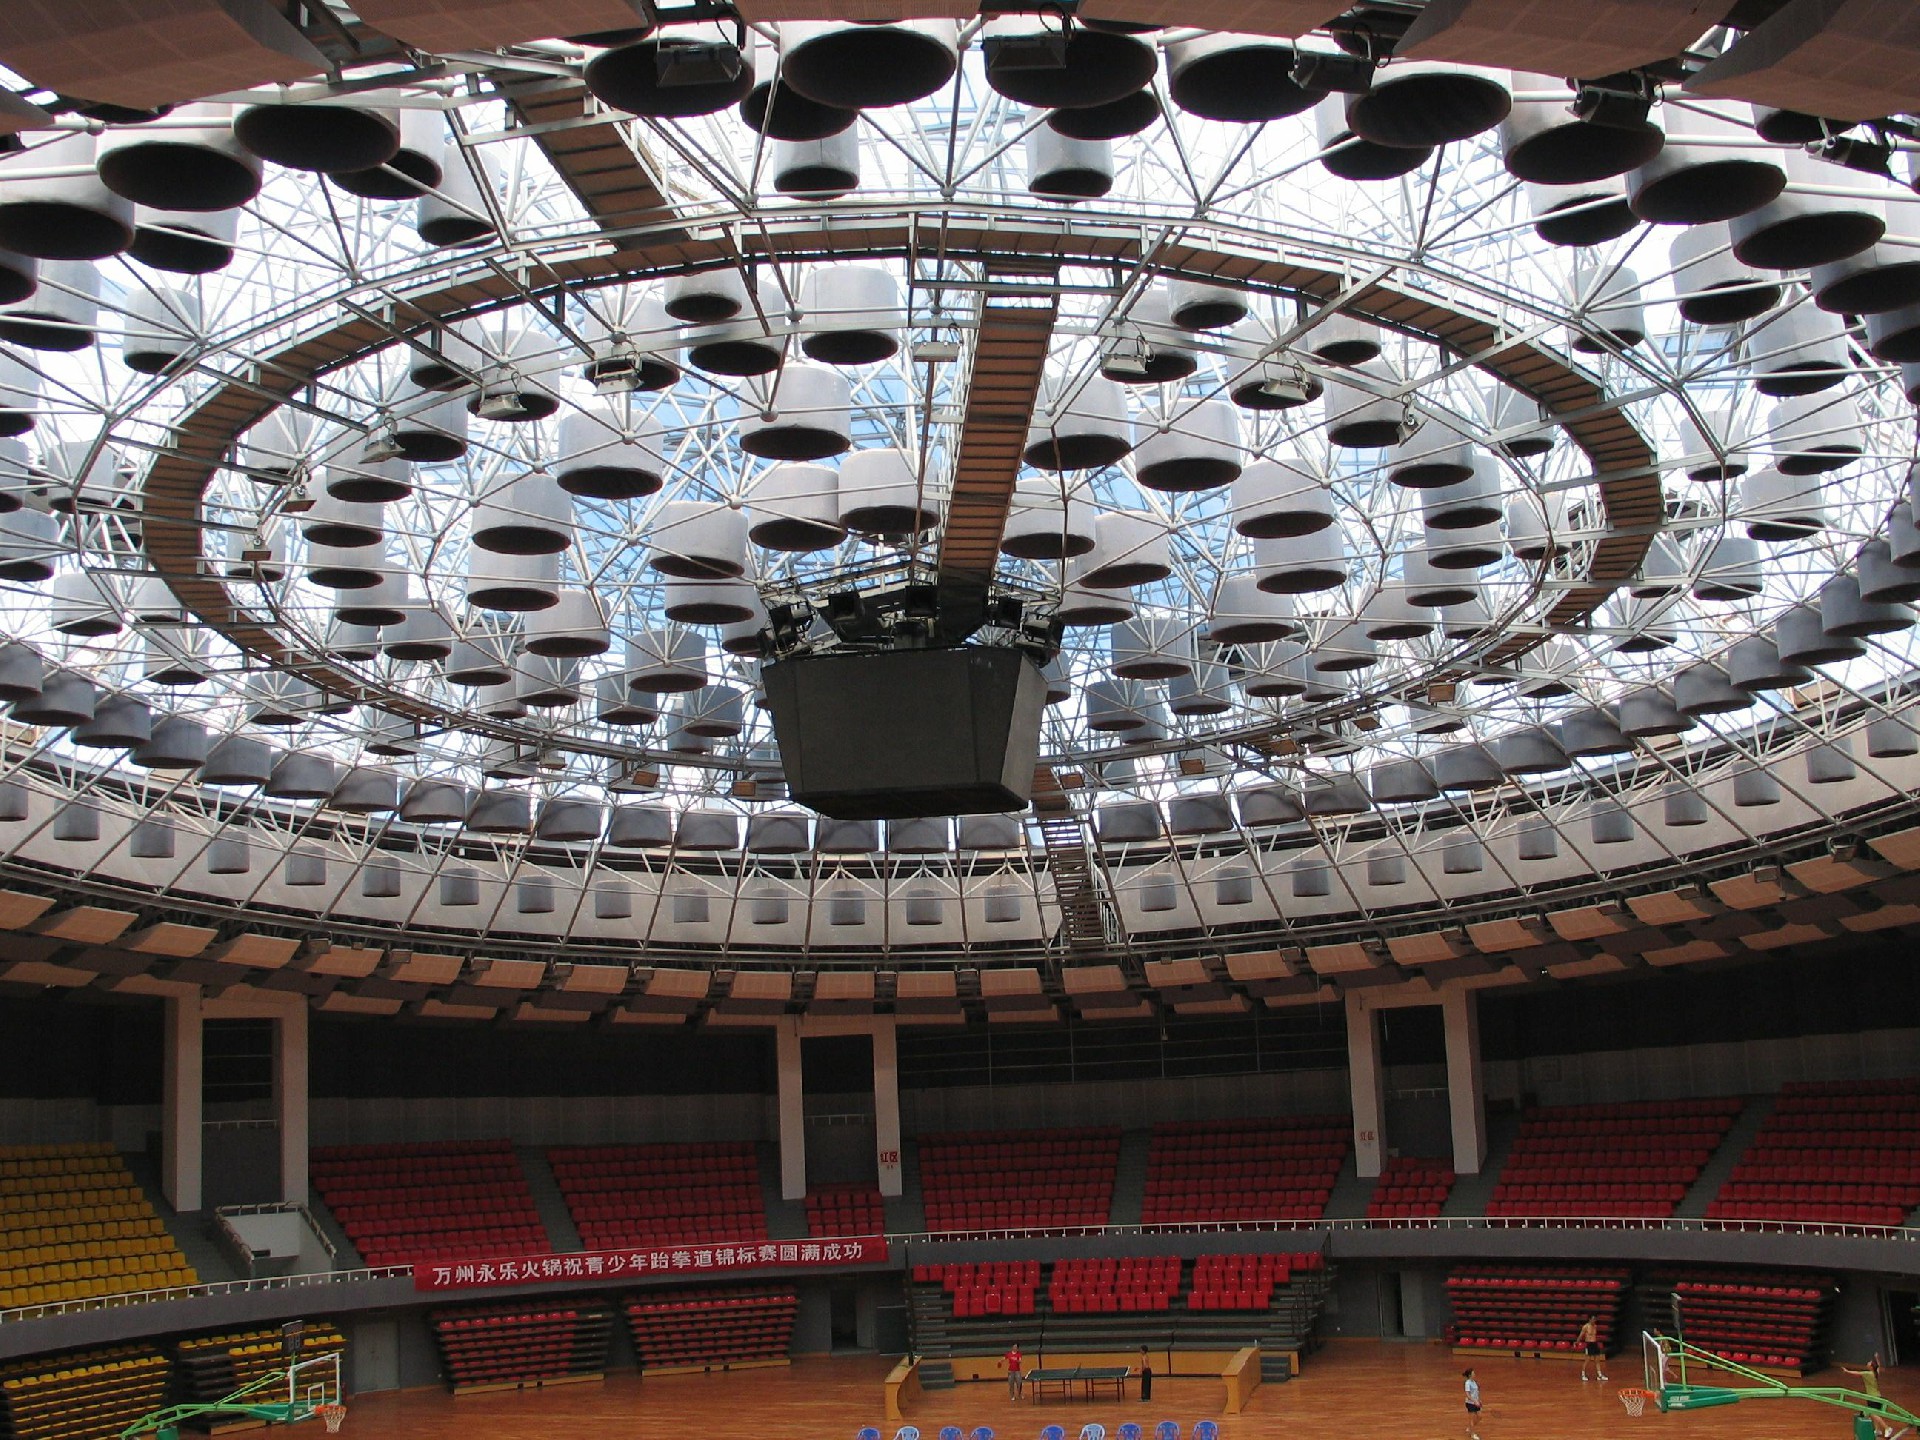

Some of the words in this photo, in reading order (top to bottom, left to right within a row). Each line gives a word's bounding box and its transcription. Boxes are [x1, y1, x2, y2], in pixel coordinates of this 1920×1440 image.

[880, 1151, 898, 1163] 红区
[433, 1241, 863, 1286] 万州永乐火锅祝青少年跆拳道锦标赛圆满成功
